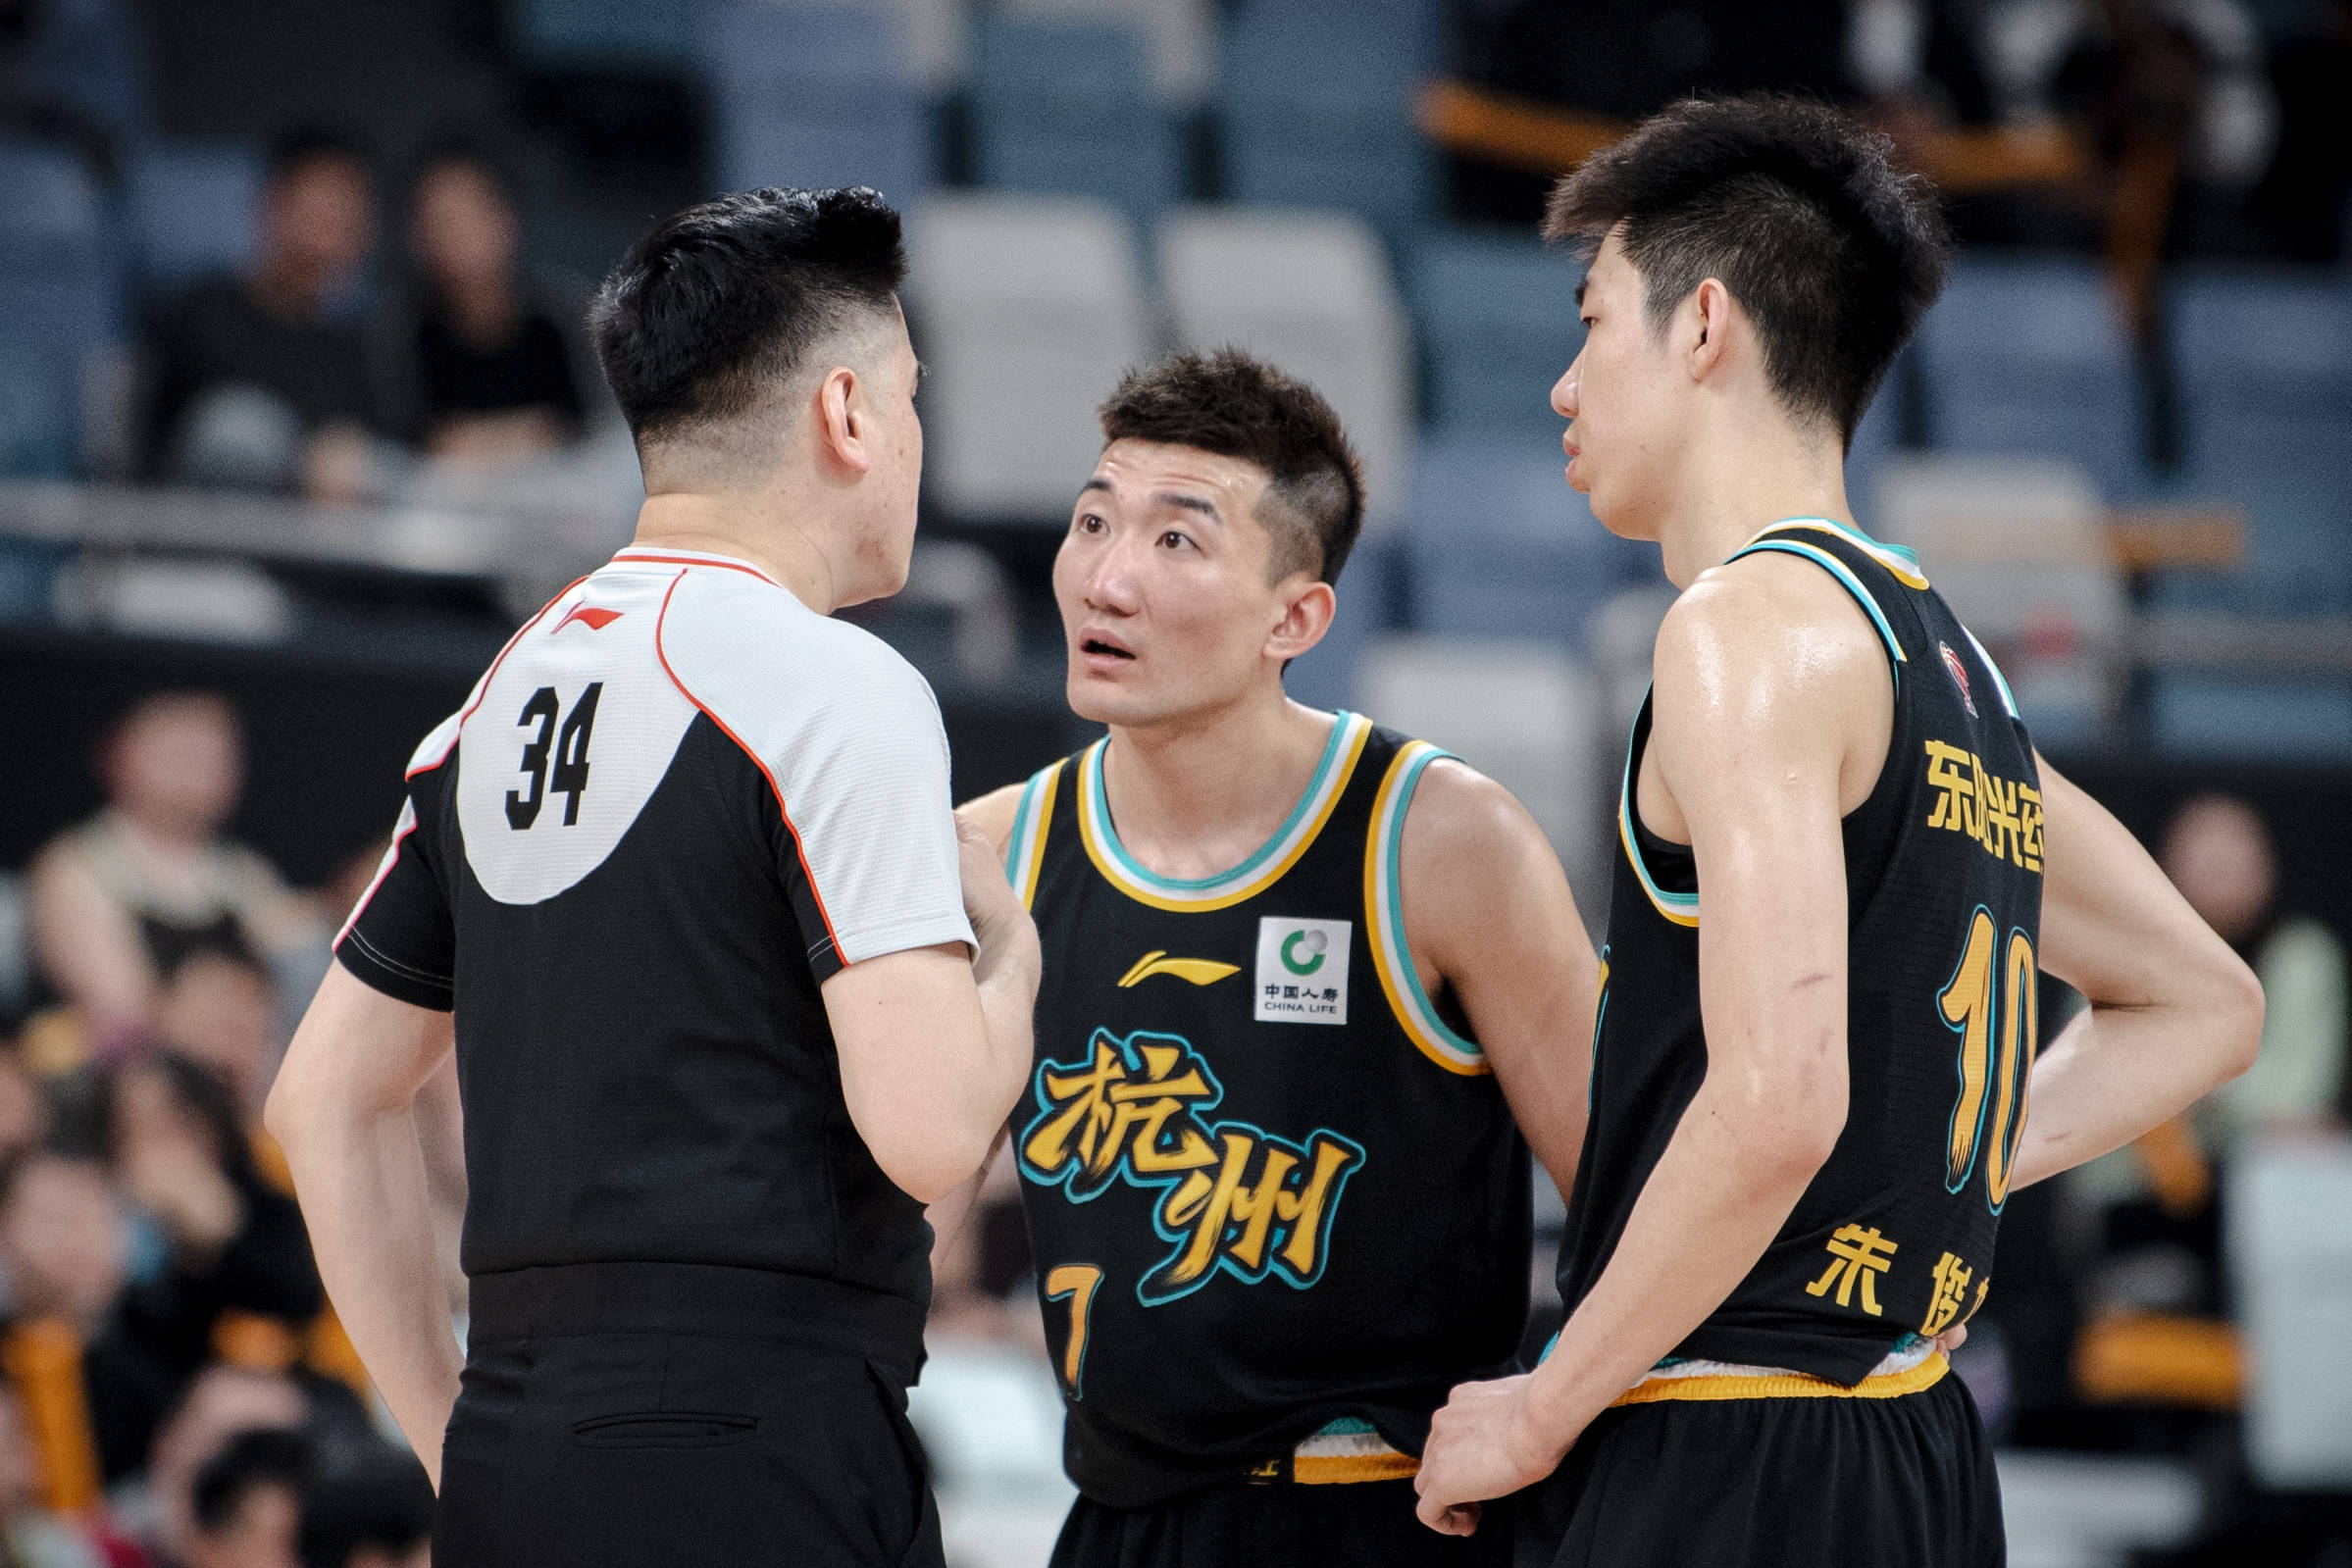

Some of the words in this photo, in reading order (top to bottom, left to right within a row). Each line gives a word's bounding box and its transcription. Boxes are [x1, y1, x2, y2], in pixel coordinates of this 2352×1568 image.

[504, 682, 604, 831] 34
[1264, 1002, 1304, 1012] CHINA
[1309, 1005, 1337, 1014] LIFE
[1265, 984, 1338, 1001] 中国人寿
[1937, 903, 2038, 1216] 10
[1020, 1027, 1366, 1307] 杭州
[1046, 1263, 1104, 1401] 7
[1806, 1223, 1990, 1337] 朱俊
